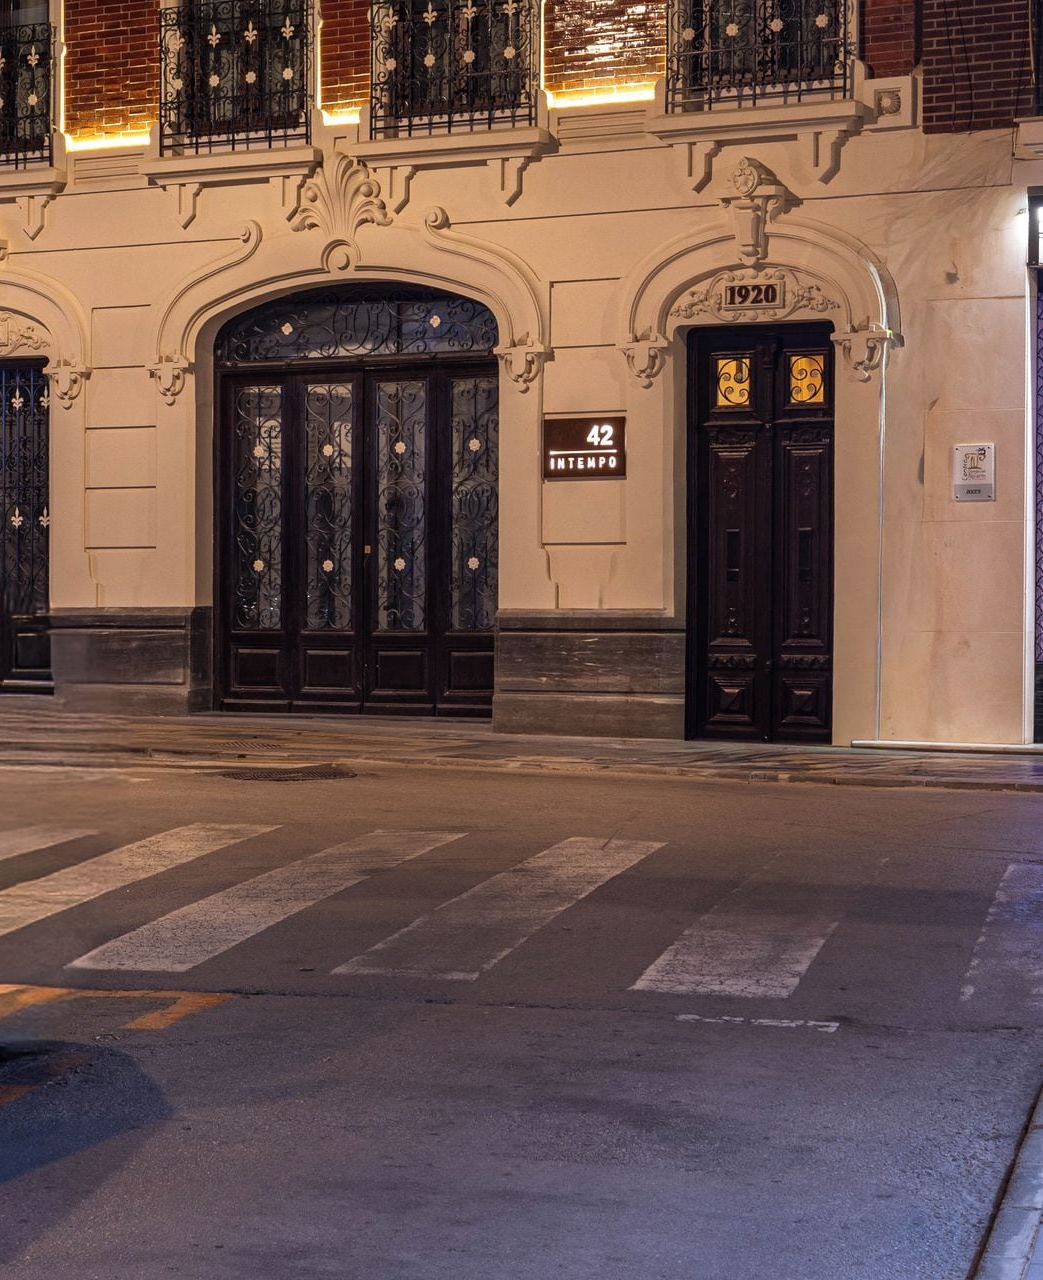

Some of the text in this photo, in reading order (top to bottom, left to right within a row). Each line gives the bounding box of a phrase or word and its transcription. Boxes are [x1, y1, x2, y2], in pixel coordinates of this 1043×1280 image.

[728, 284, 777, 305] 1920
[586, 424, 614, 446] 42
[549, 456, 617, 470] INTEMPO
